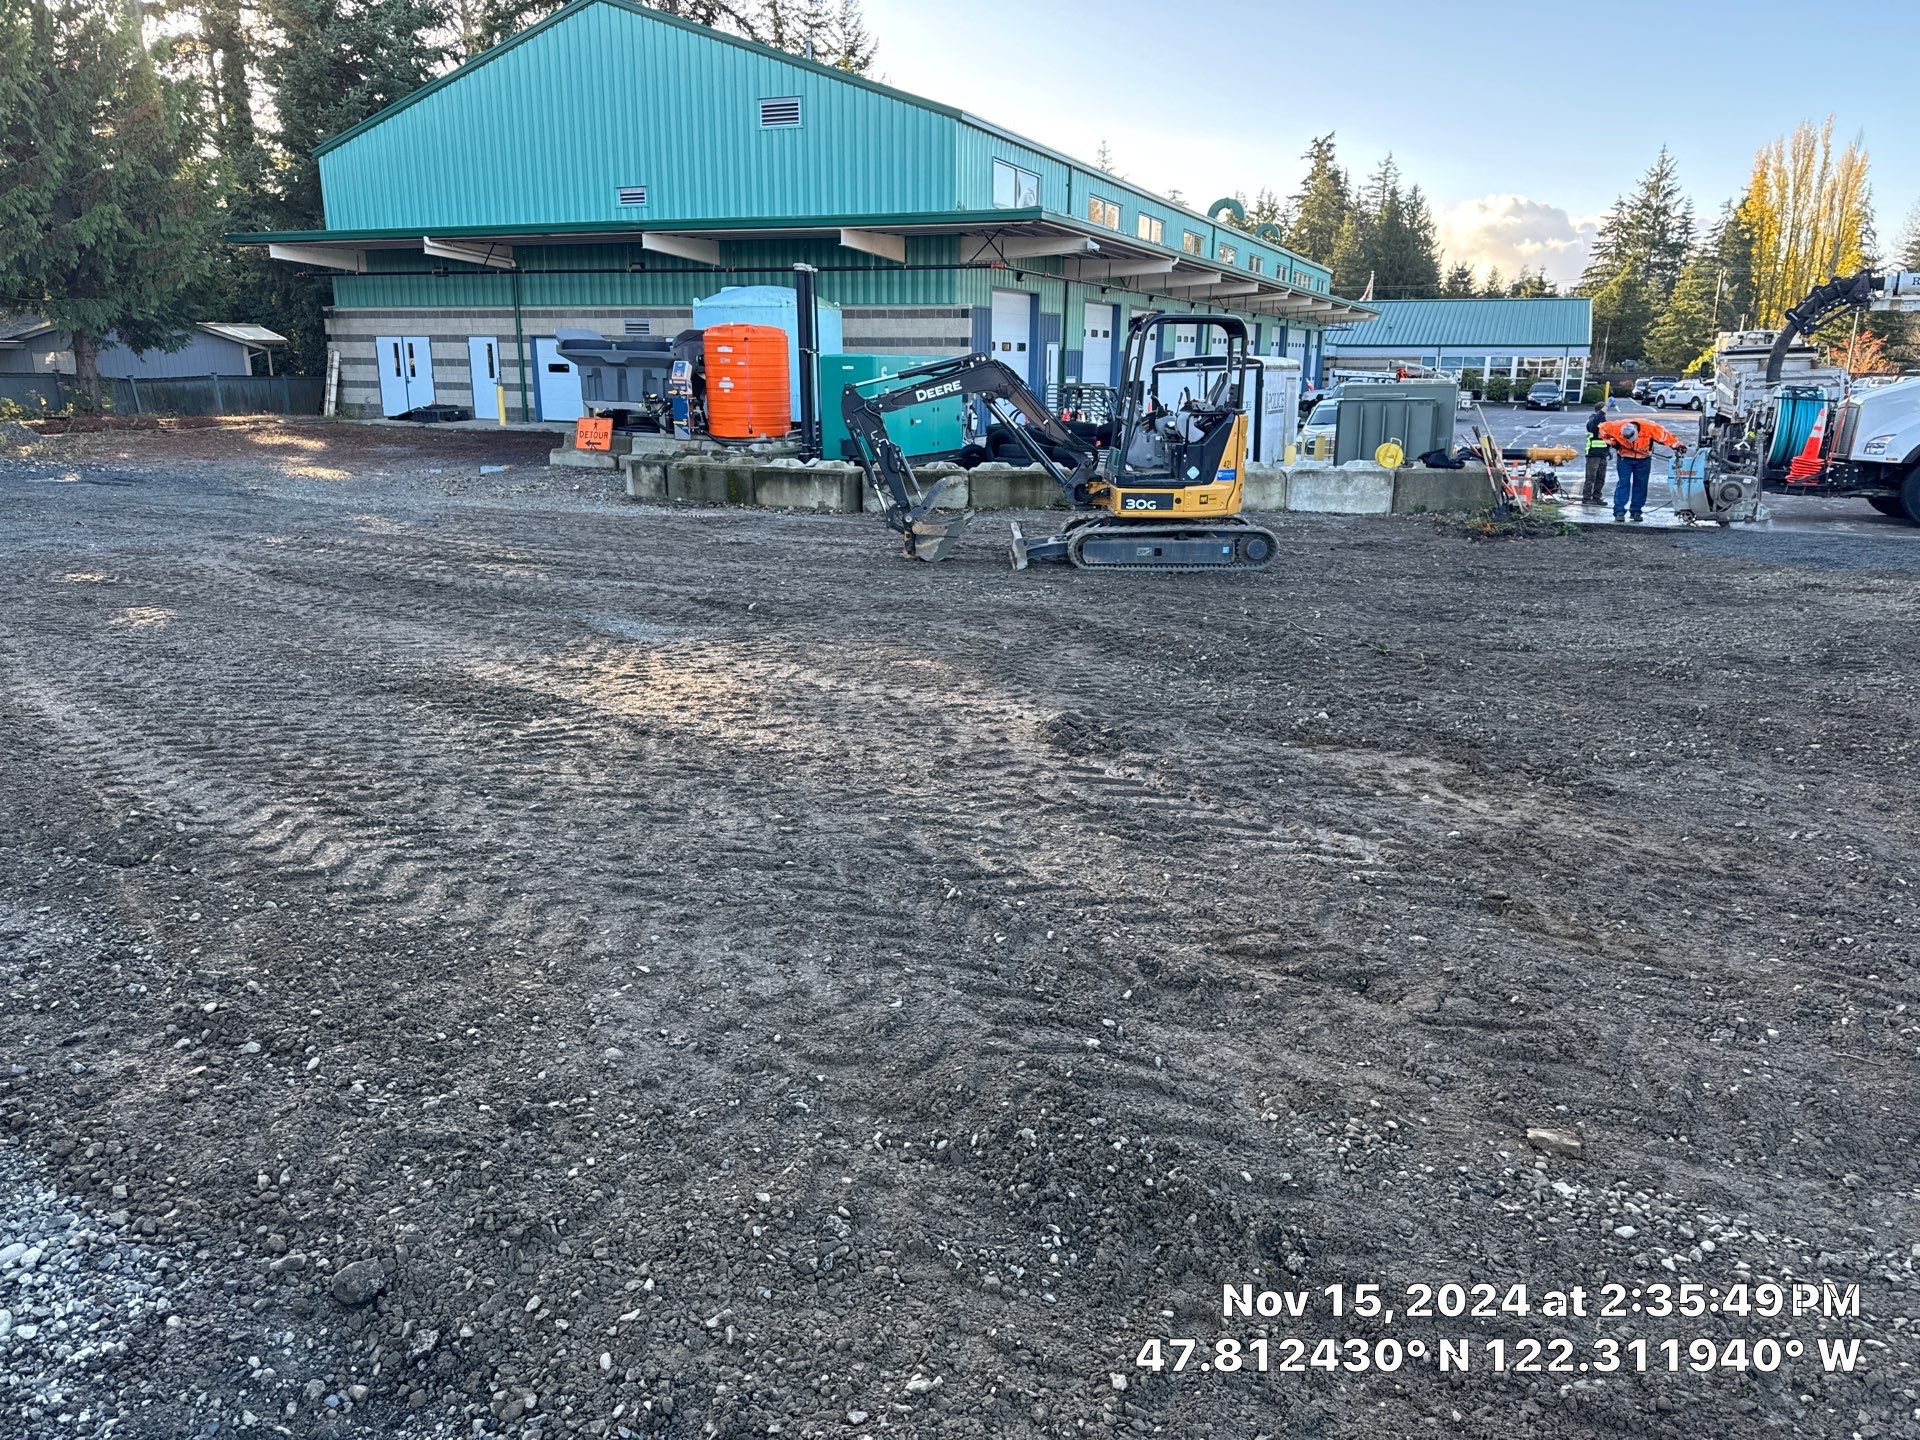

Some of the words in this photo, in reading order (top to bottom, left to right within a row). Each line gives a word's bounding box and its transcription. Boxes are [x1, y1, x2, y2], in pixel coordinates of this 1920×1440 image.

[915, 380, 962, 402] DEERE
[579, 430, 609, 440] DETOUR
[1125, 498, 1157, 510] 30G
